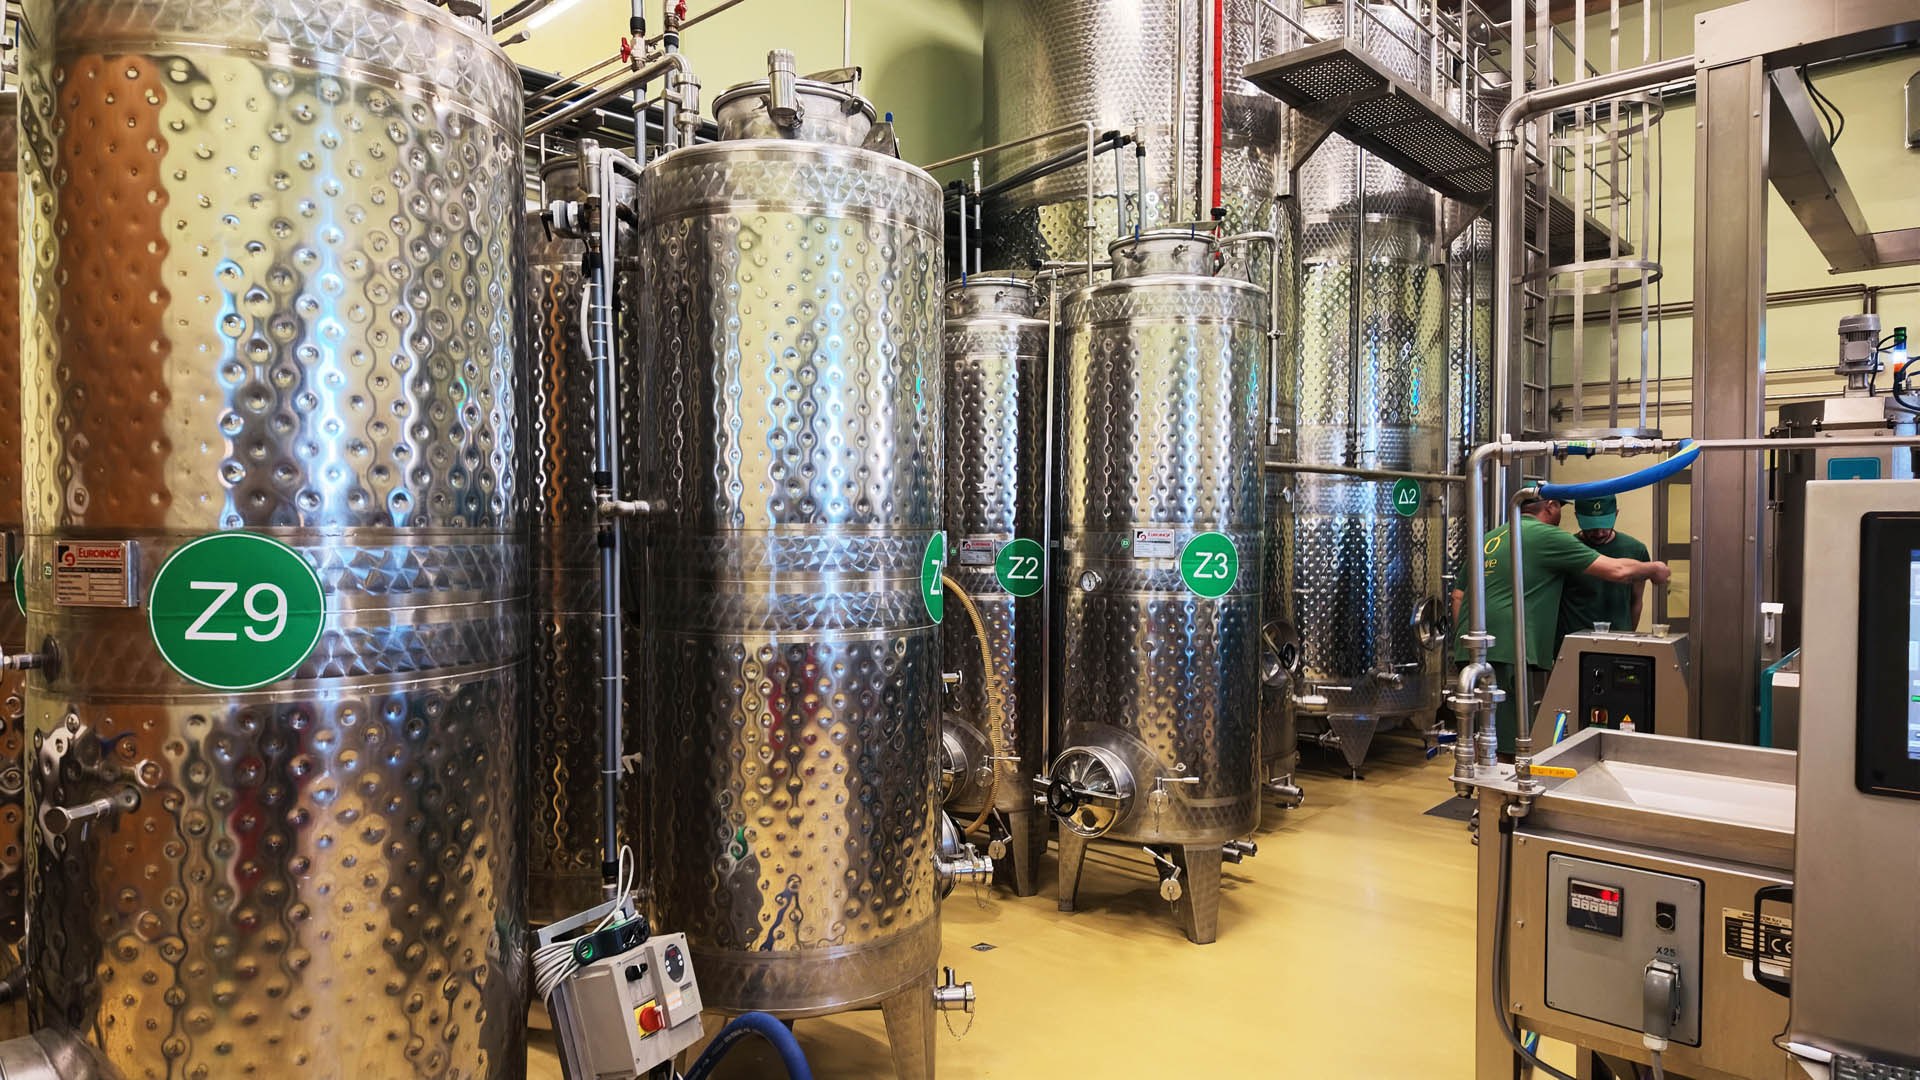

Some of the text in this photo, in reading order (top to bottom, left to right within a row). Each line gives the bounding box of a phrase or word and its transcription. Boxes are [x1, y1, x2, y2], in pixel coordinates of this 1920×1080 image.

[1007, 556, 1039, 580] Z2
[1193, 552, 1229, 579] Z3
[184, 581, 288, 642] Z9
[1656, 946, 1676, 957] X25
